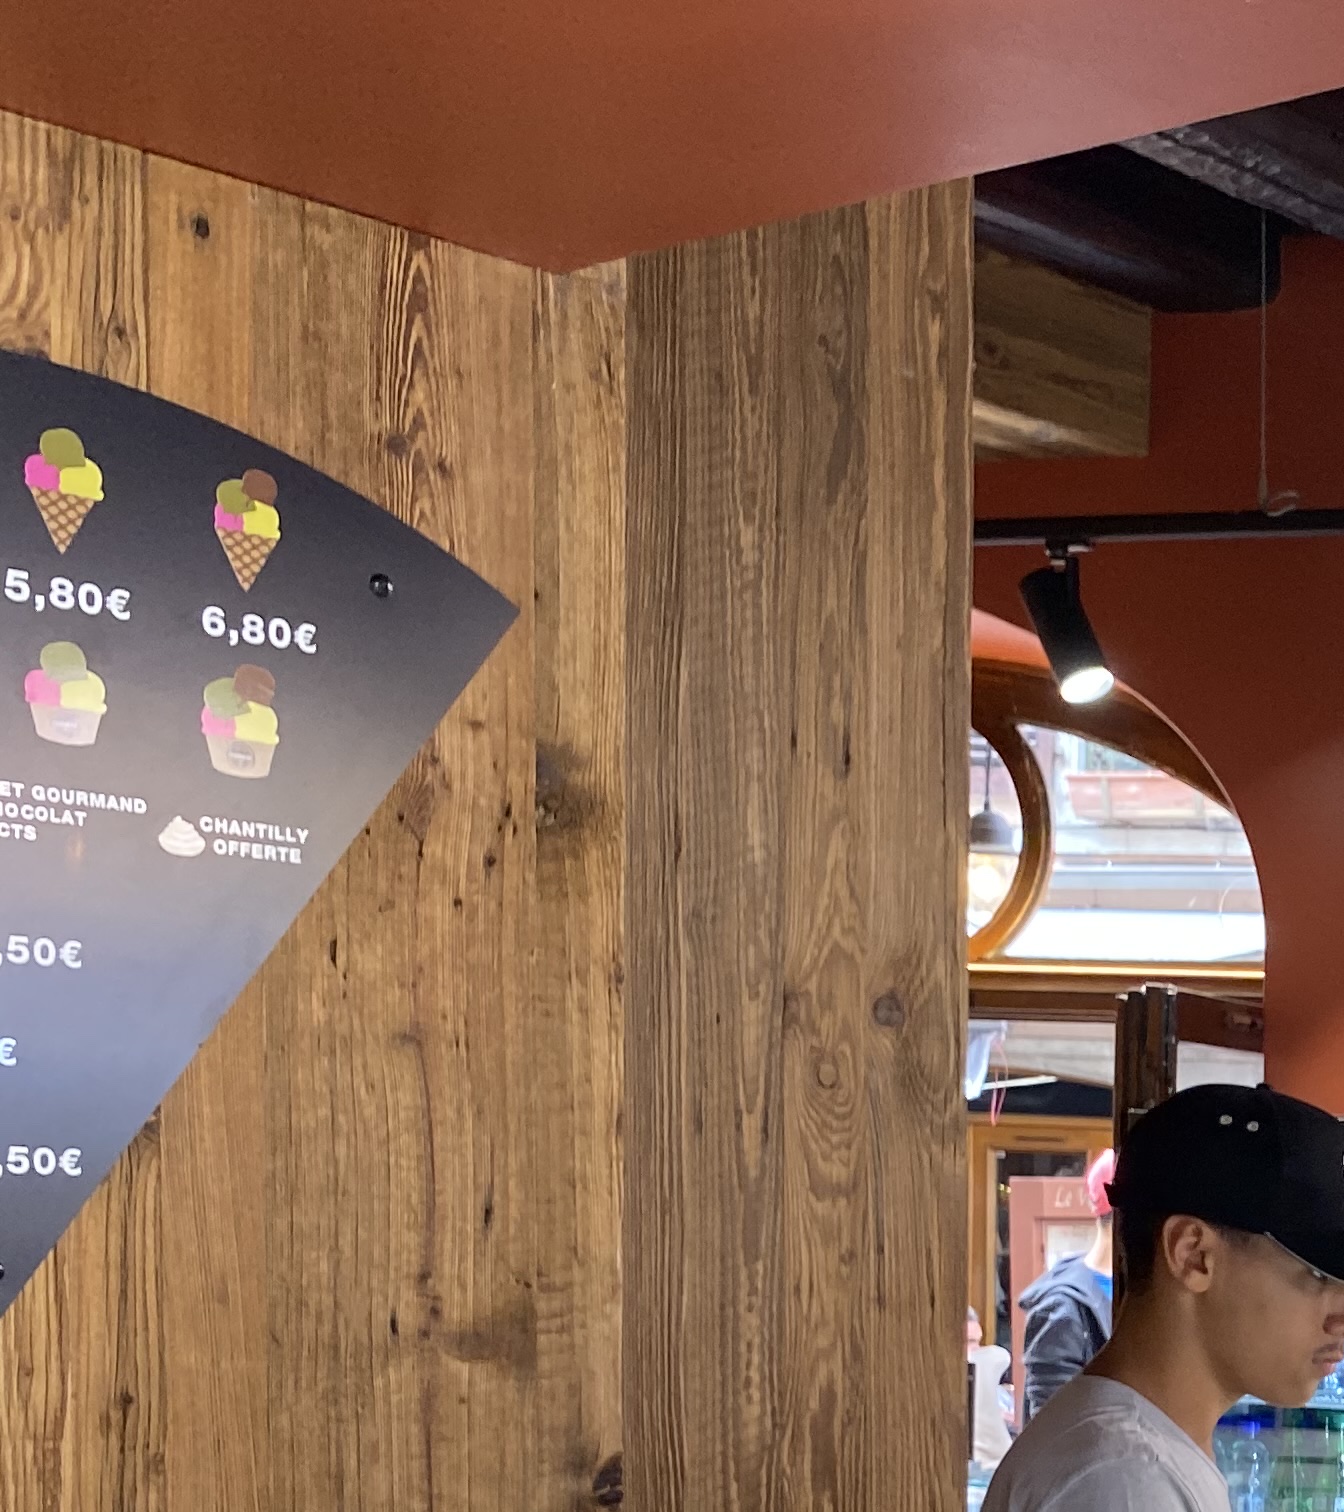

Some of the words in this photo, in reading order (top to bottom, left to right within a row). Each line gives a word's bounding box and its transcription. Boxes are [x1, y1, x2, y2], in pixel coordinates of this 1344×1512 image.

[3, 567, 132, 621] 5,80€
[201, 606, 318, 654] 6,80€
[0, 801, 88, 827] OCOLAT
[31, 785, 148, 815] GOURMAND
[200, 815, 310, 845] CHANTILLY
[213, 839, 303, 864] OFFERTE
[0, 934, 83, 970] 50€
[0, 1145, 83, 1178] 50€
